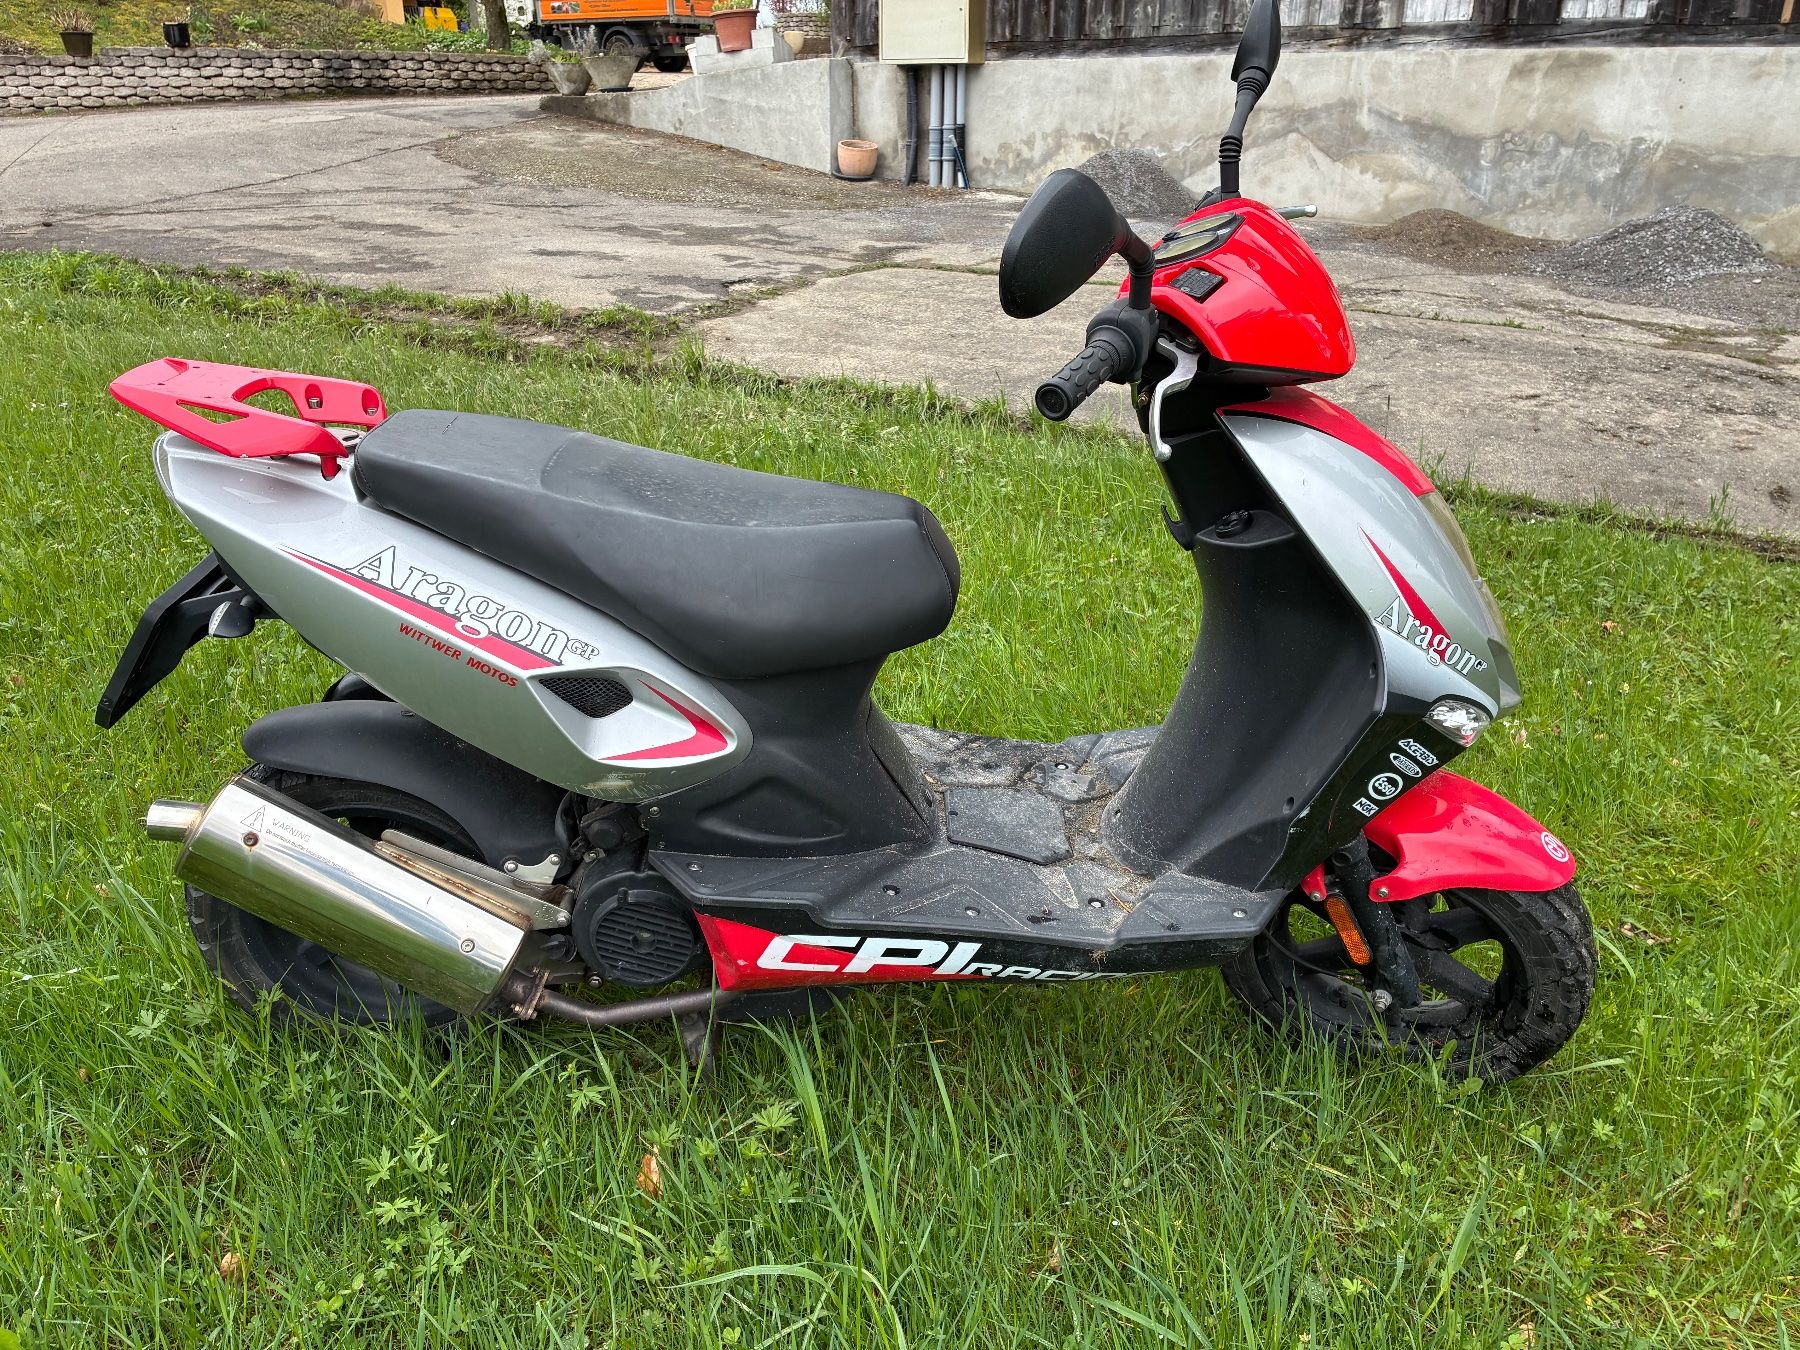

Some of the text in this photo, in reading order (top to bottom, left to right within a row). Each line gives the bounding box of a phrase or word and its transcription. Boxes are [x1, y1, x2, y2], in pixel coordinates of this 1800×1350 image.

[344, 545, 600, 666] Aragon GP
[399, 621, 519, 688] WITTWER MOTOS
[1374, 595, 1488, 677] Aragon GP
[272, 817, 311, 843] WARNING
[1355, 799, 1377, 816] NGK
[756, 934, 983, 975] CPI
